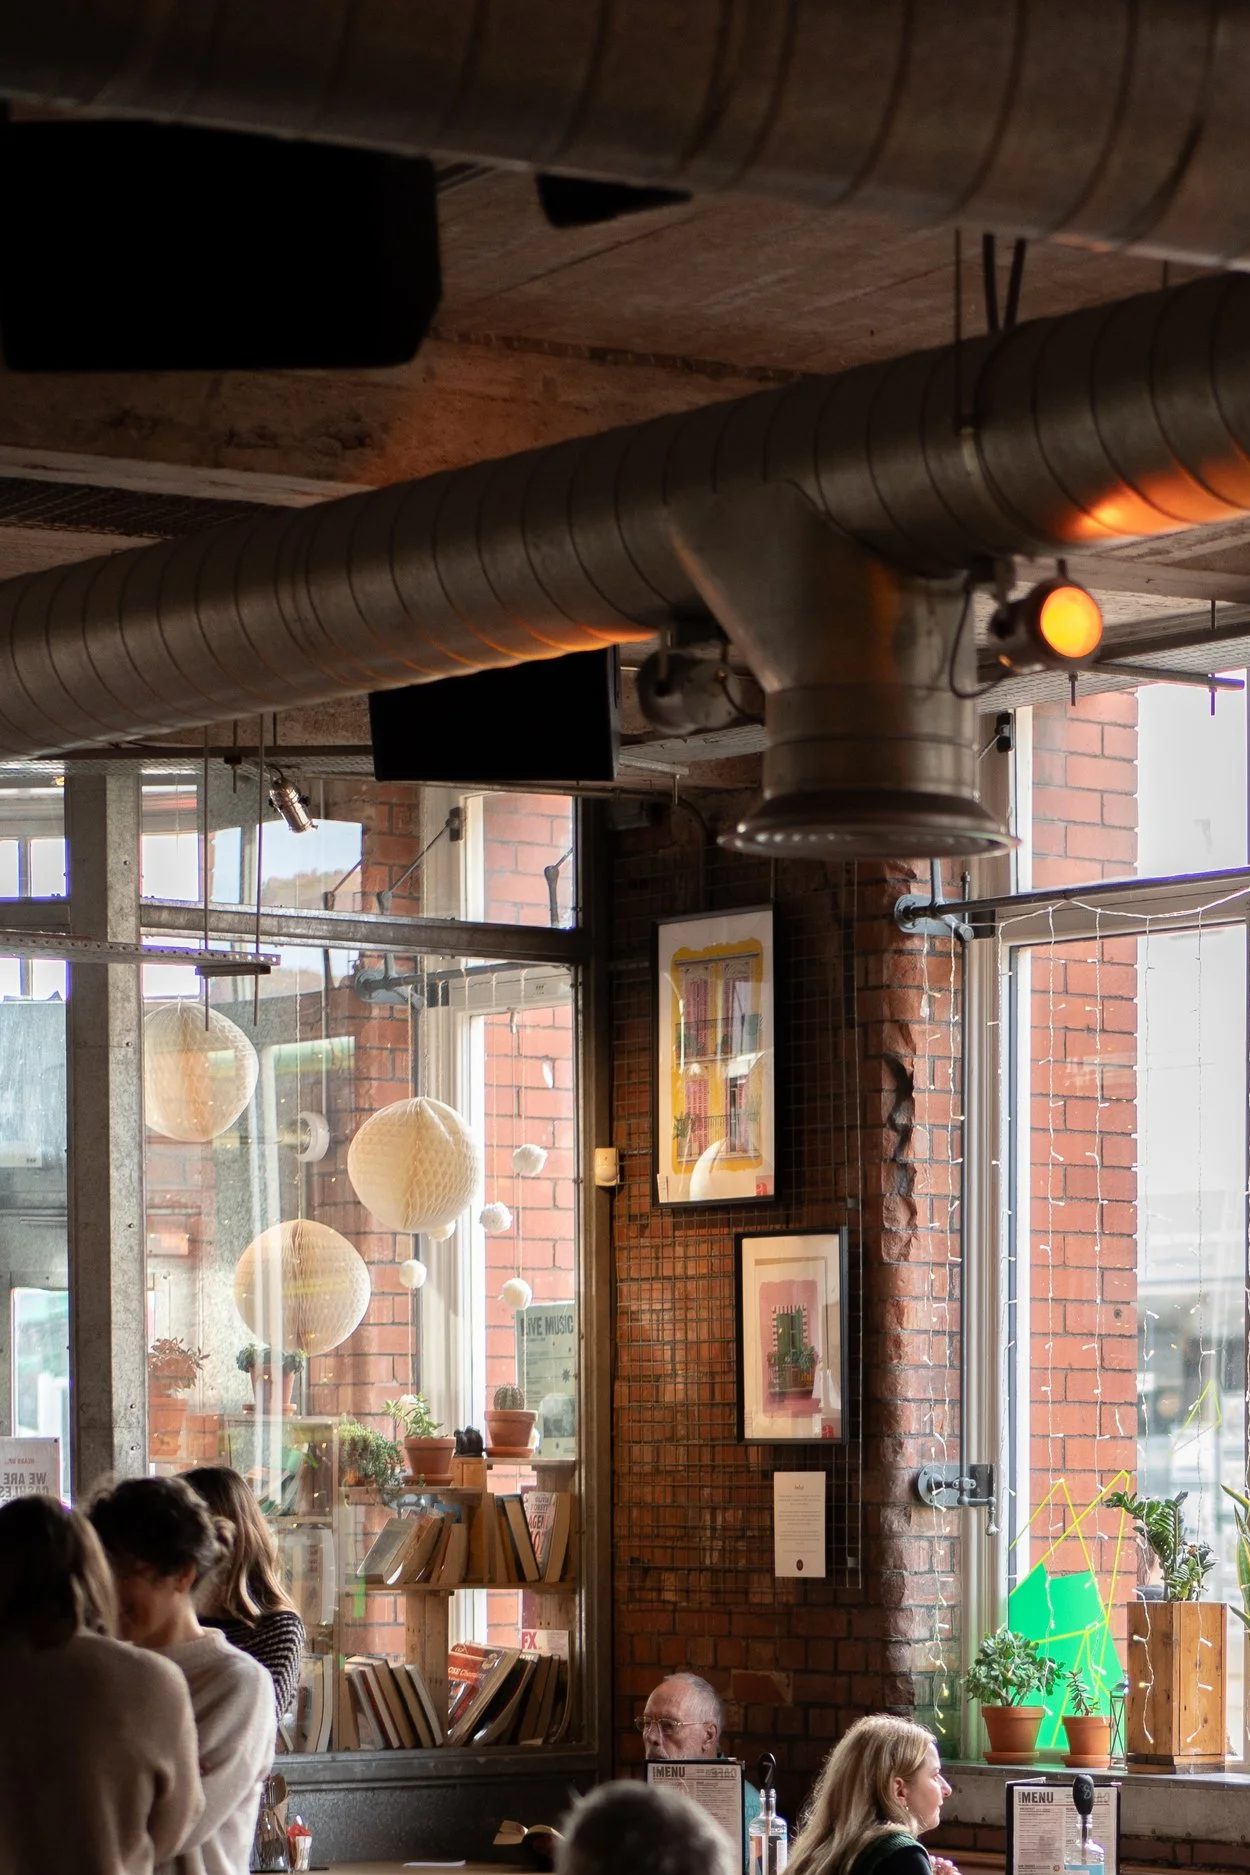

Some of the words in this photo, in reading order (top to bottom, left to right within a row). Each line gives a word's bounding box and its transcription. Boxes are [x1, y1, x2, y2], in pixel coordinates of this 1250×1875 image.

[520, 1316, 542, 1337] LIVE
[545, 1315, 574, 1336] MUSIC
[656, 1766, 686, 1778] MENU
[763, 1762, 773, 1783] 7
[1021, 1791, 1054, 1804] MENU
[1083, 1784, 1092, 1799] 8
